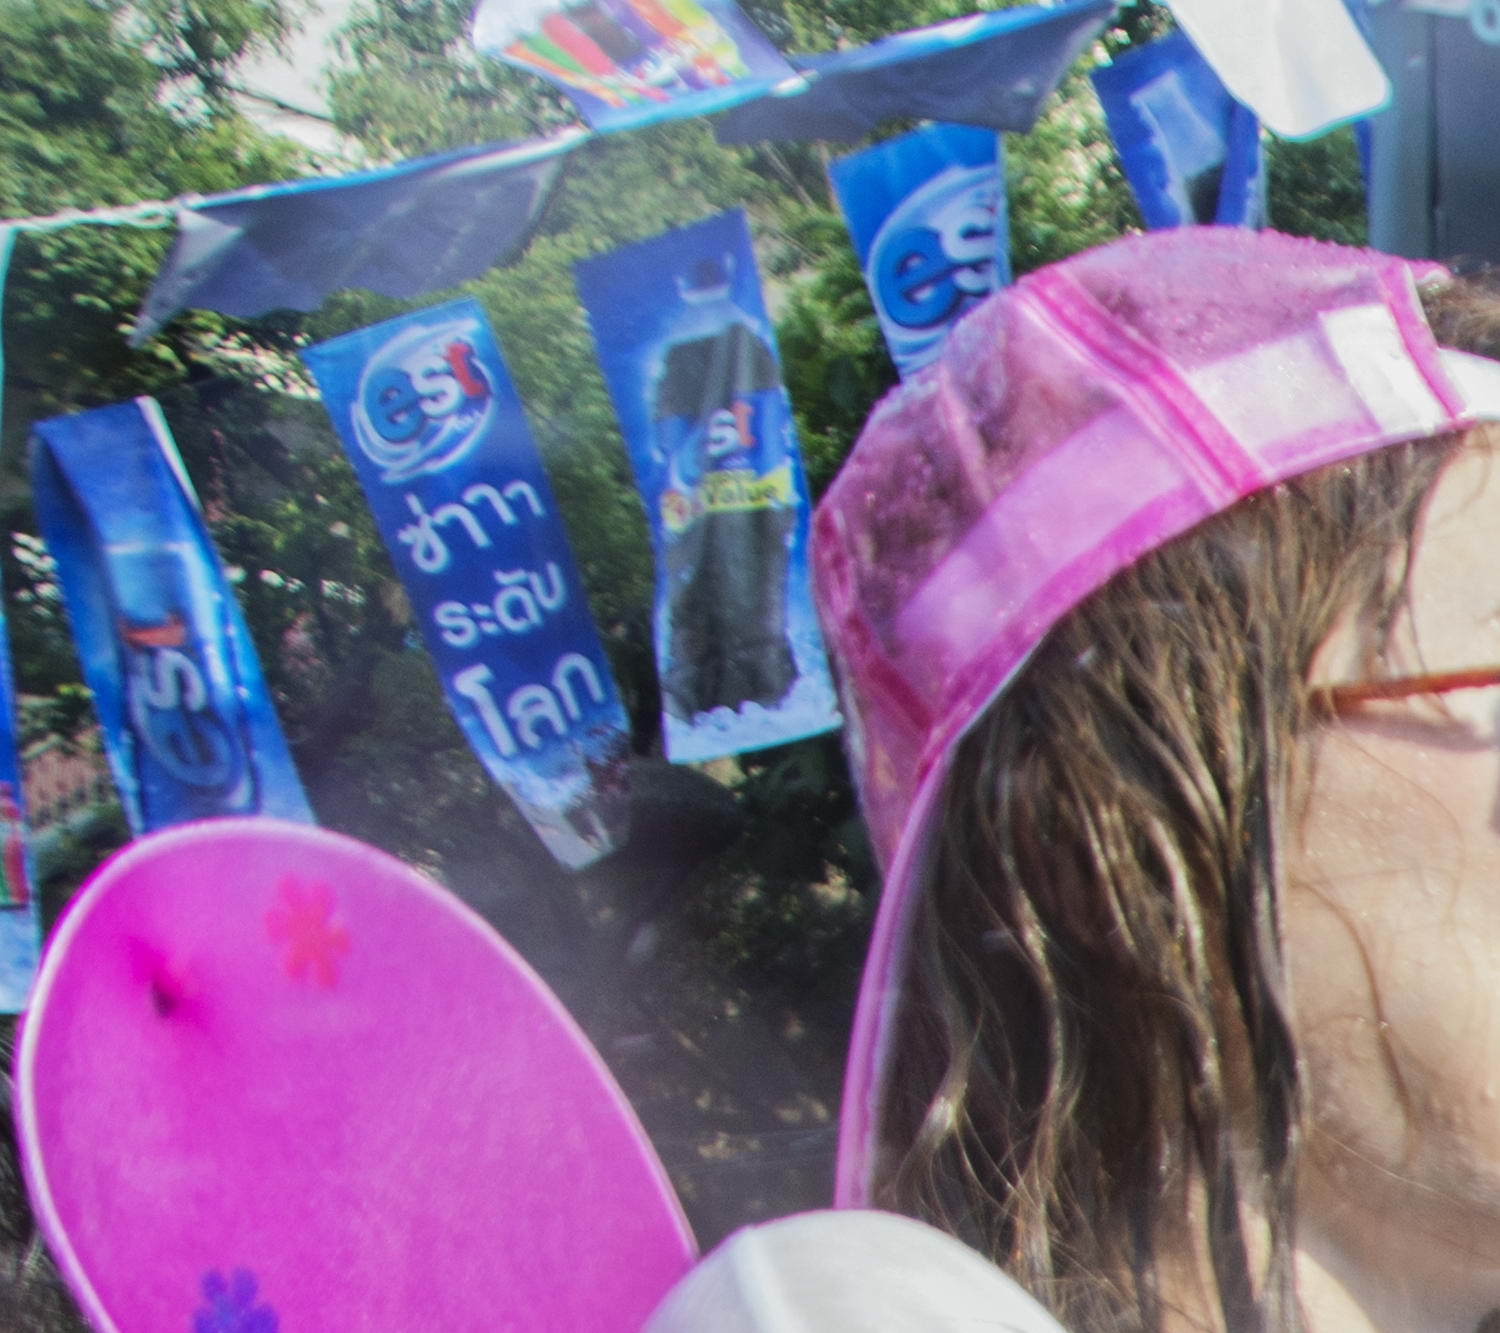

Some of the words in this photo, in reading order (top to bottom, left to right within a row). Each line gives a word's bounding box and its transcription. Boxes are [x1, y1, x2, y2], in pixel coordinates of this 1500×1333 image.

[364, 340, 492, 444] est
[434, 560, 567, 649] ระดับ
[452, 652, 603, 758] โลก
